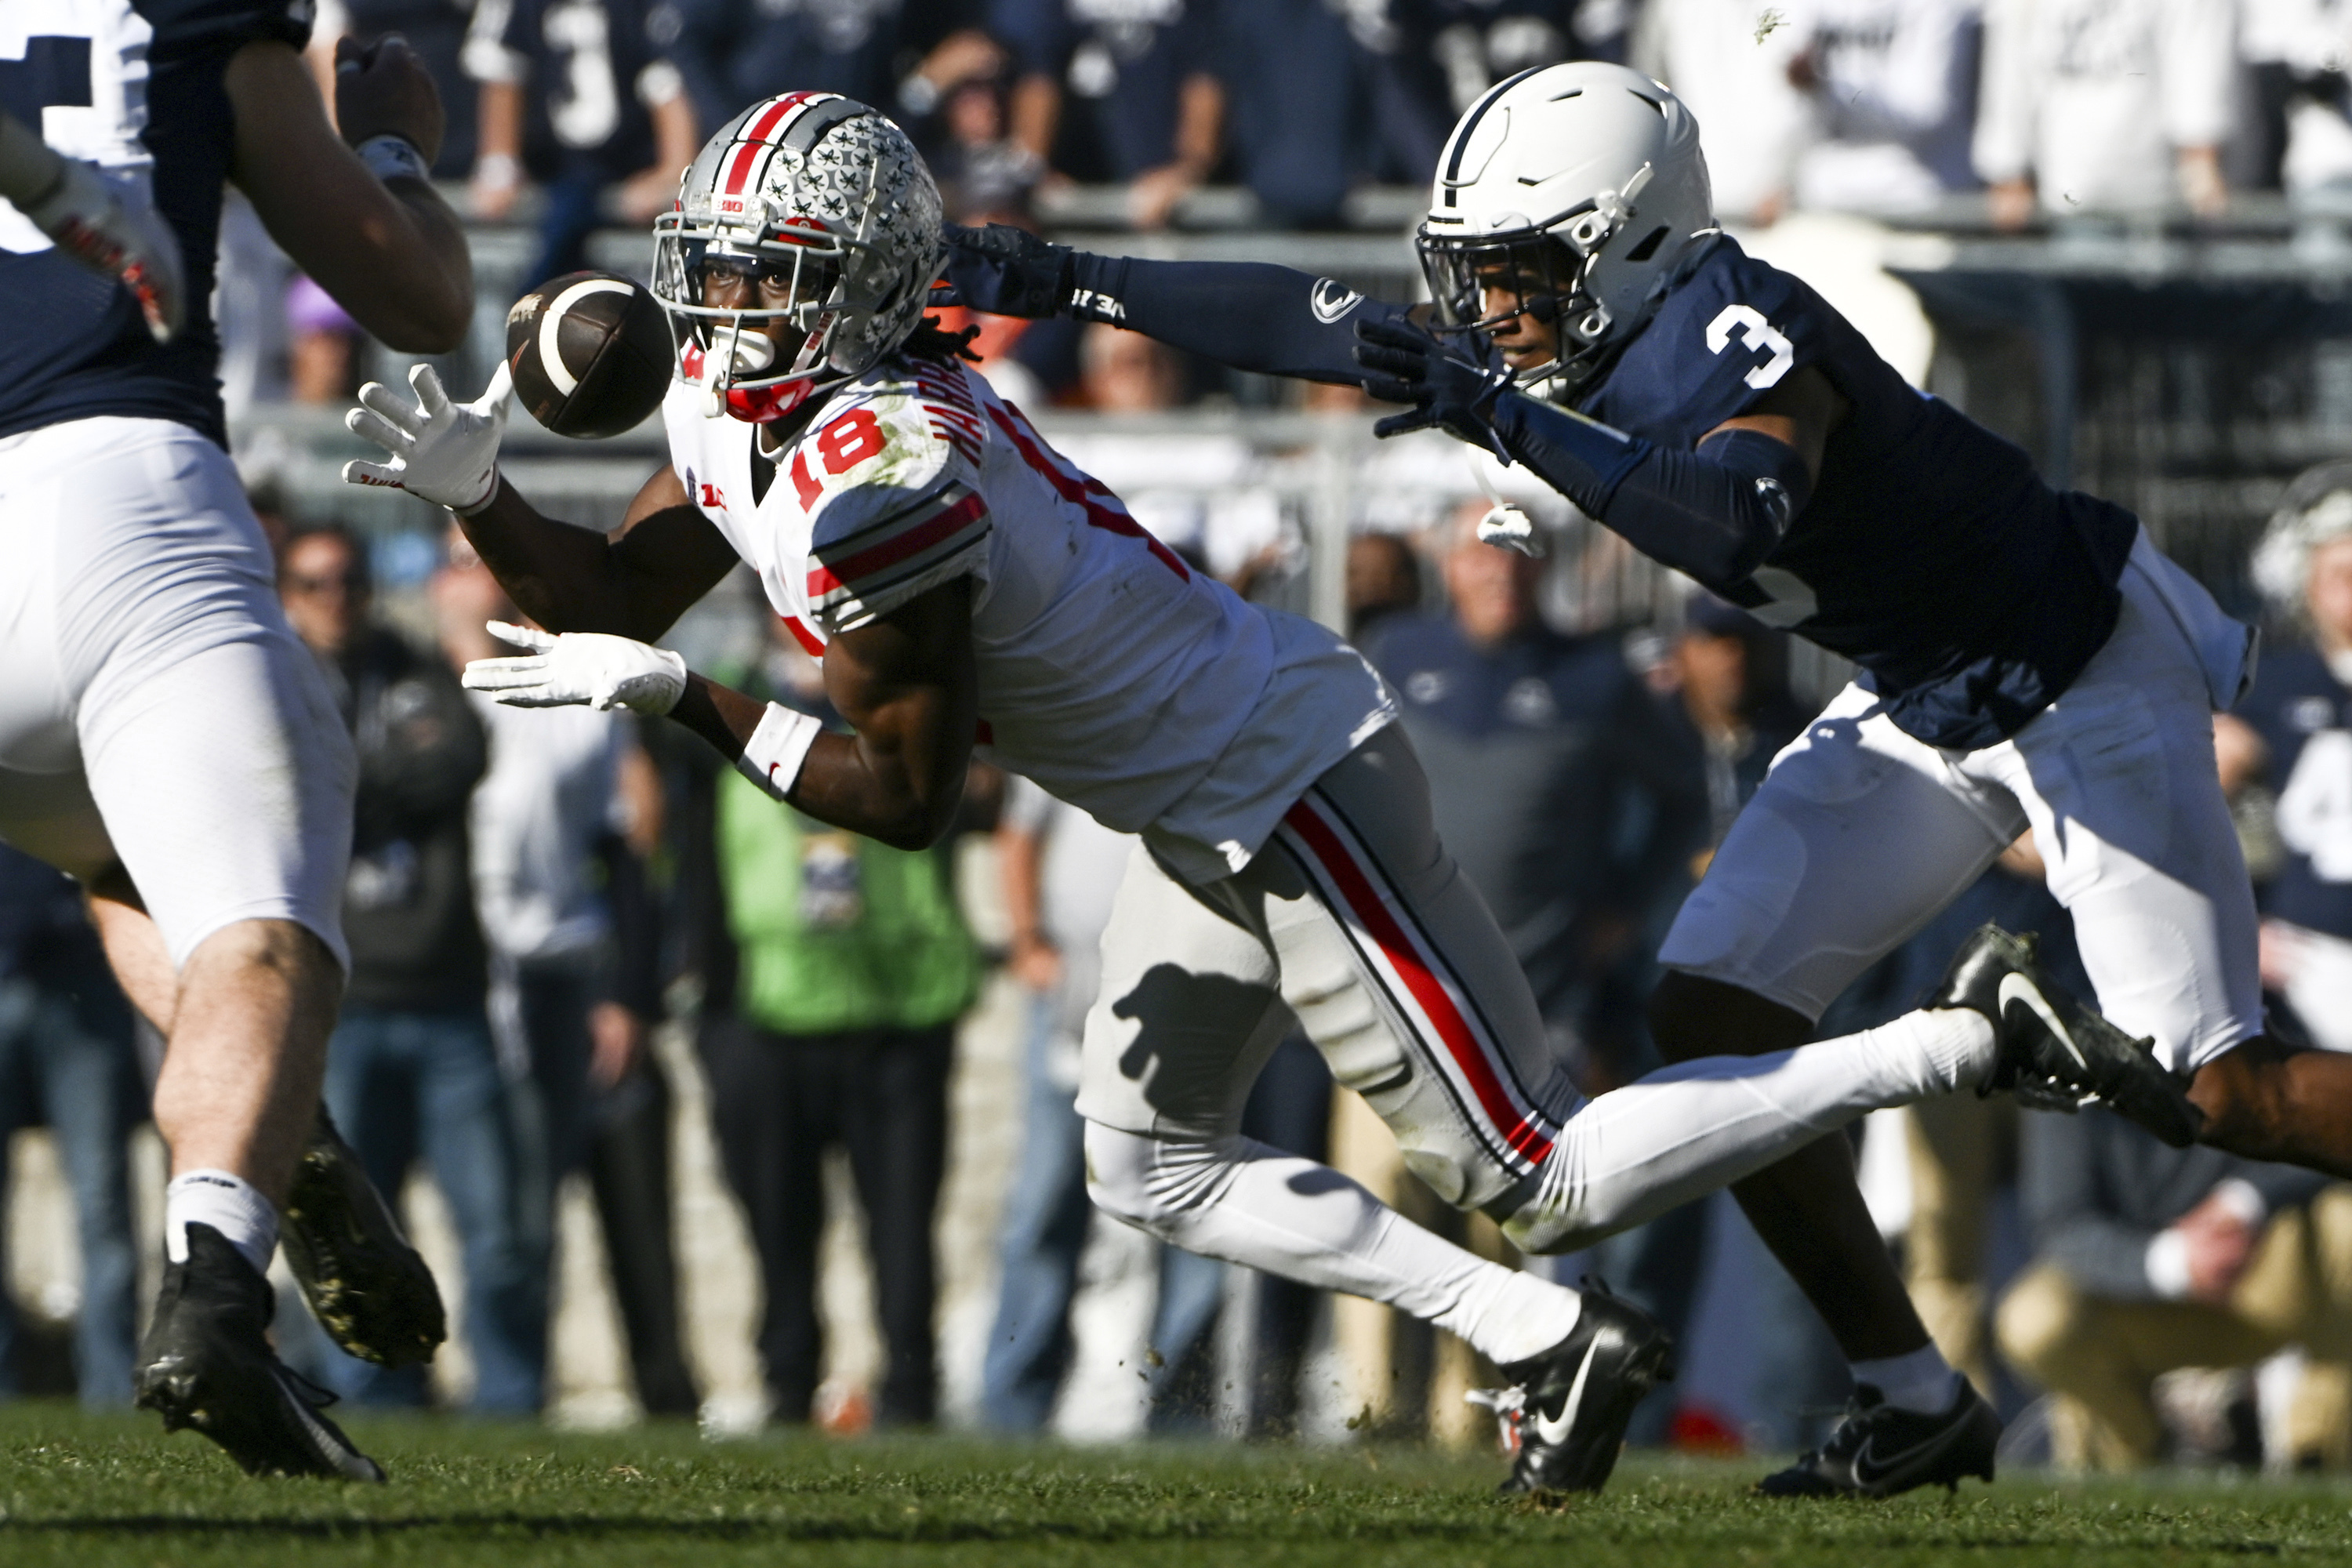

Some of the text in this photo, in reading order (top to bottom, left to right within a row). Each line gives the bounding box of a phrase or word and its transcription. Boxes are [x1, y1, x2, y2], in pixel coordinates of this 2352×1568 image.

[543, 2, 620, 148] 3
[1706, 303, 1795, 390] 3
[788, 407, 887, 514] 18
